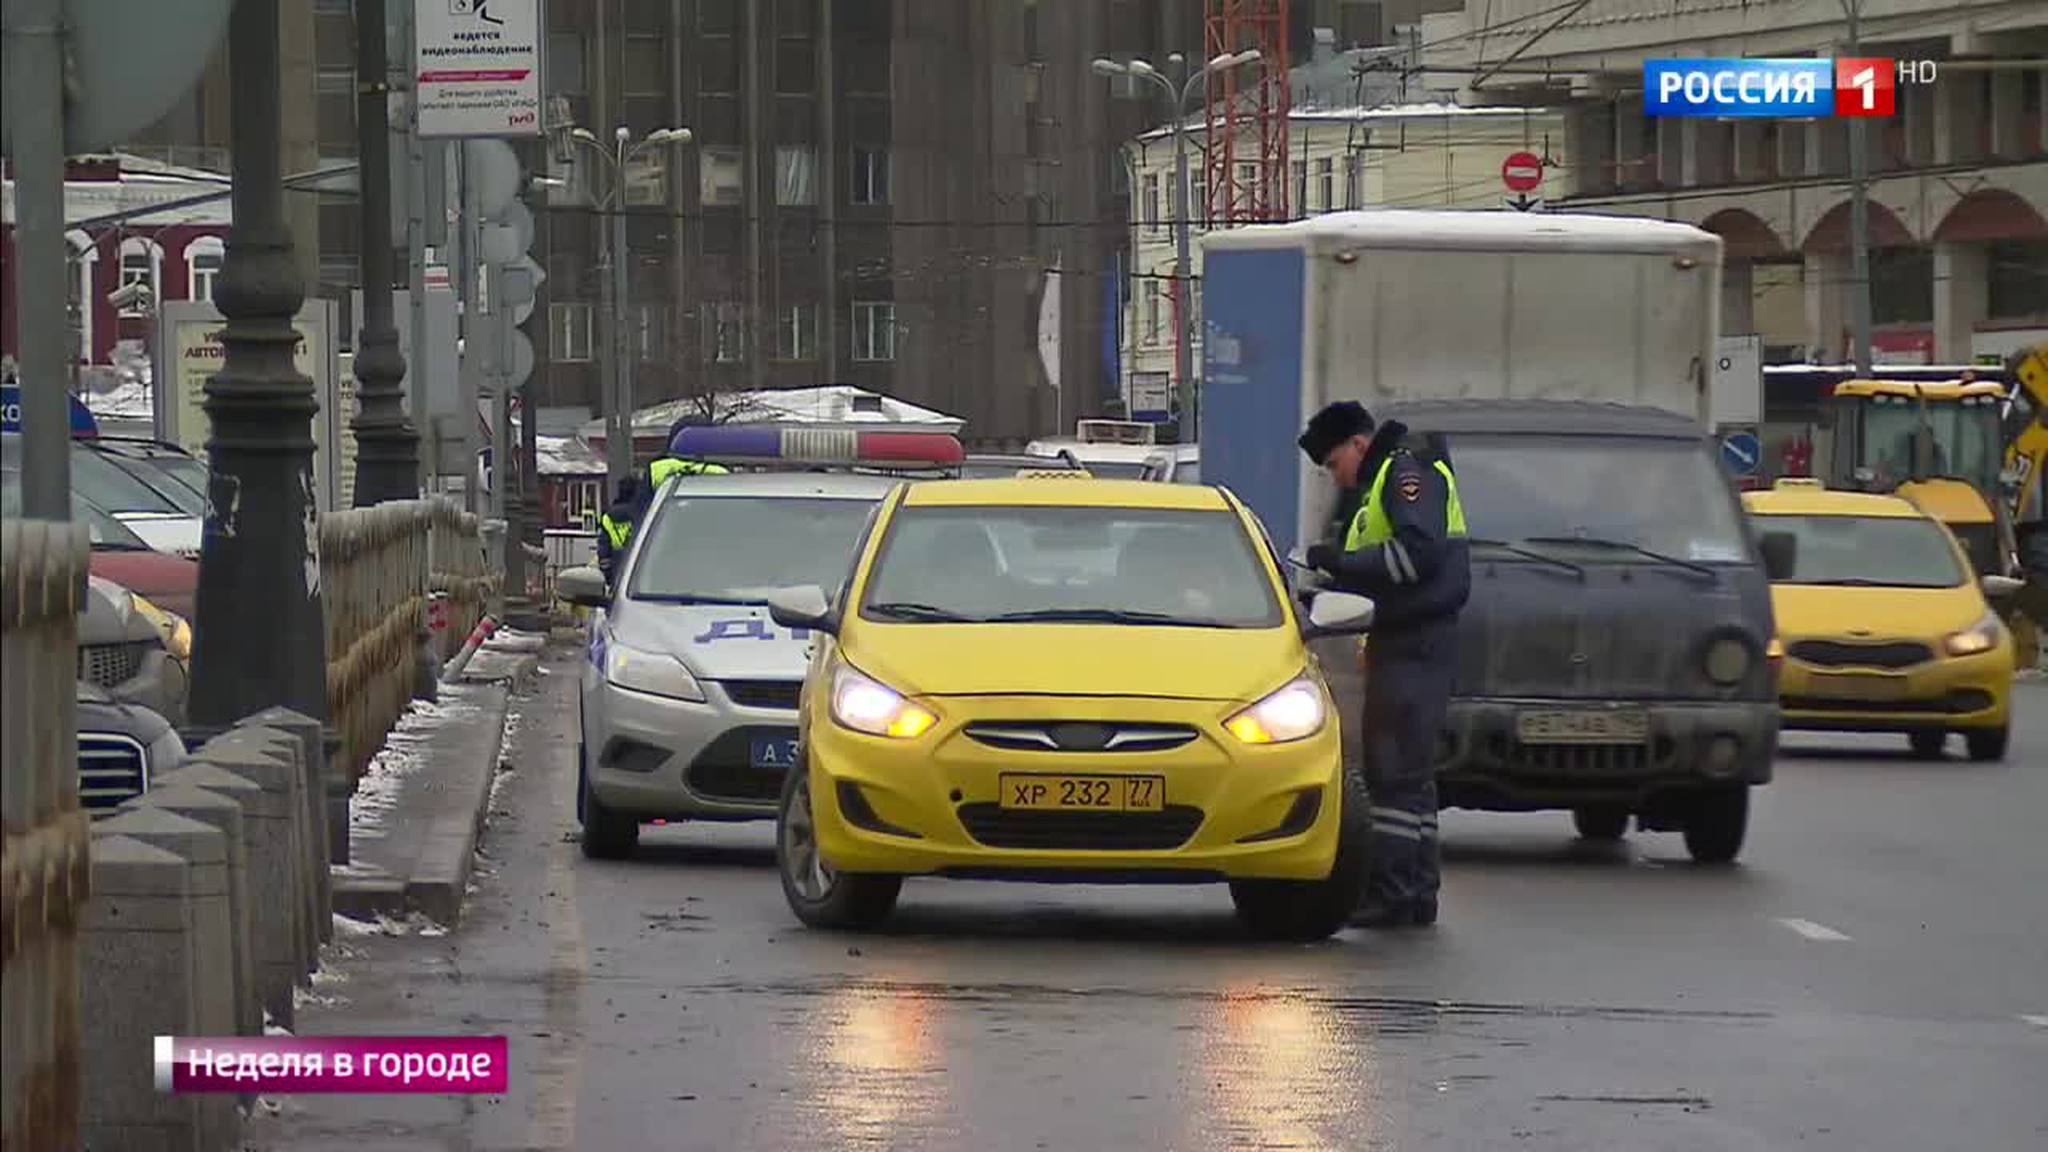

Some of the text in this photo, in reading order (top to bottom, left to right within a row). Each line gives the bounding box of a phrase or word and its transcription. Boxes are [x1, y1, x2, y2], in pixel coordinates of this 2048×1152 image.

[454, 32, 500, 41] ведется
[422, 45, 533, 56] видеонаблюдение
[763, 743, 777, 762] А
[1014, 779, 1153, 807] ХР 232 77
